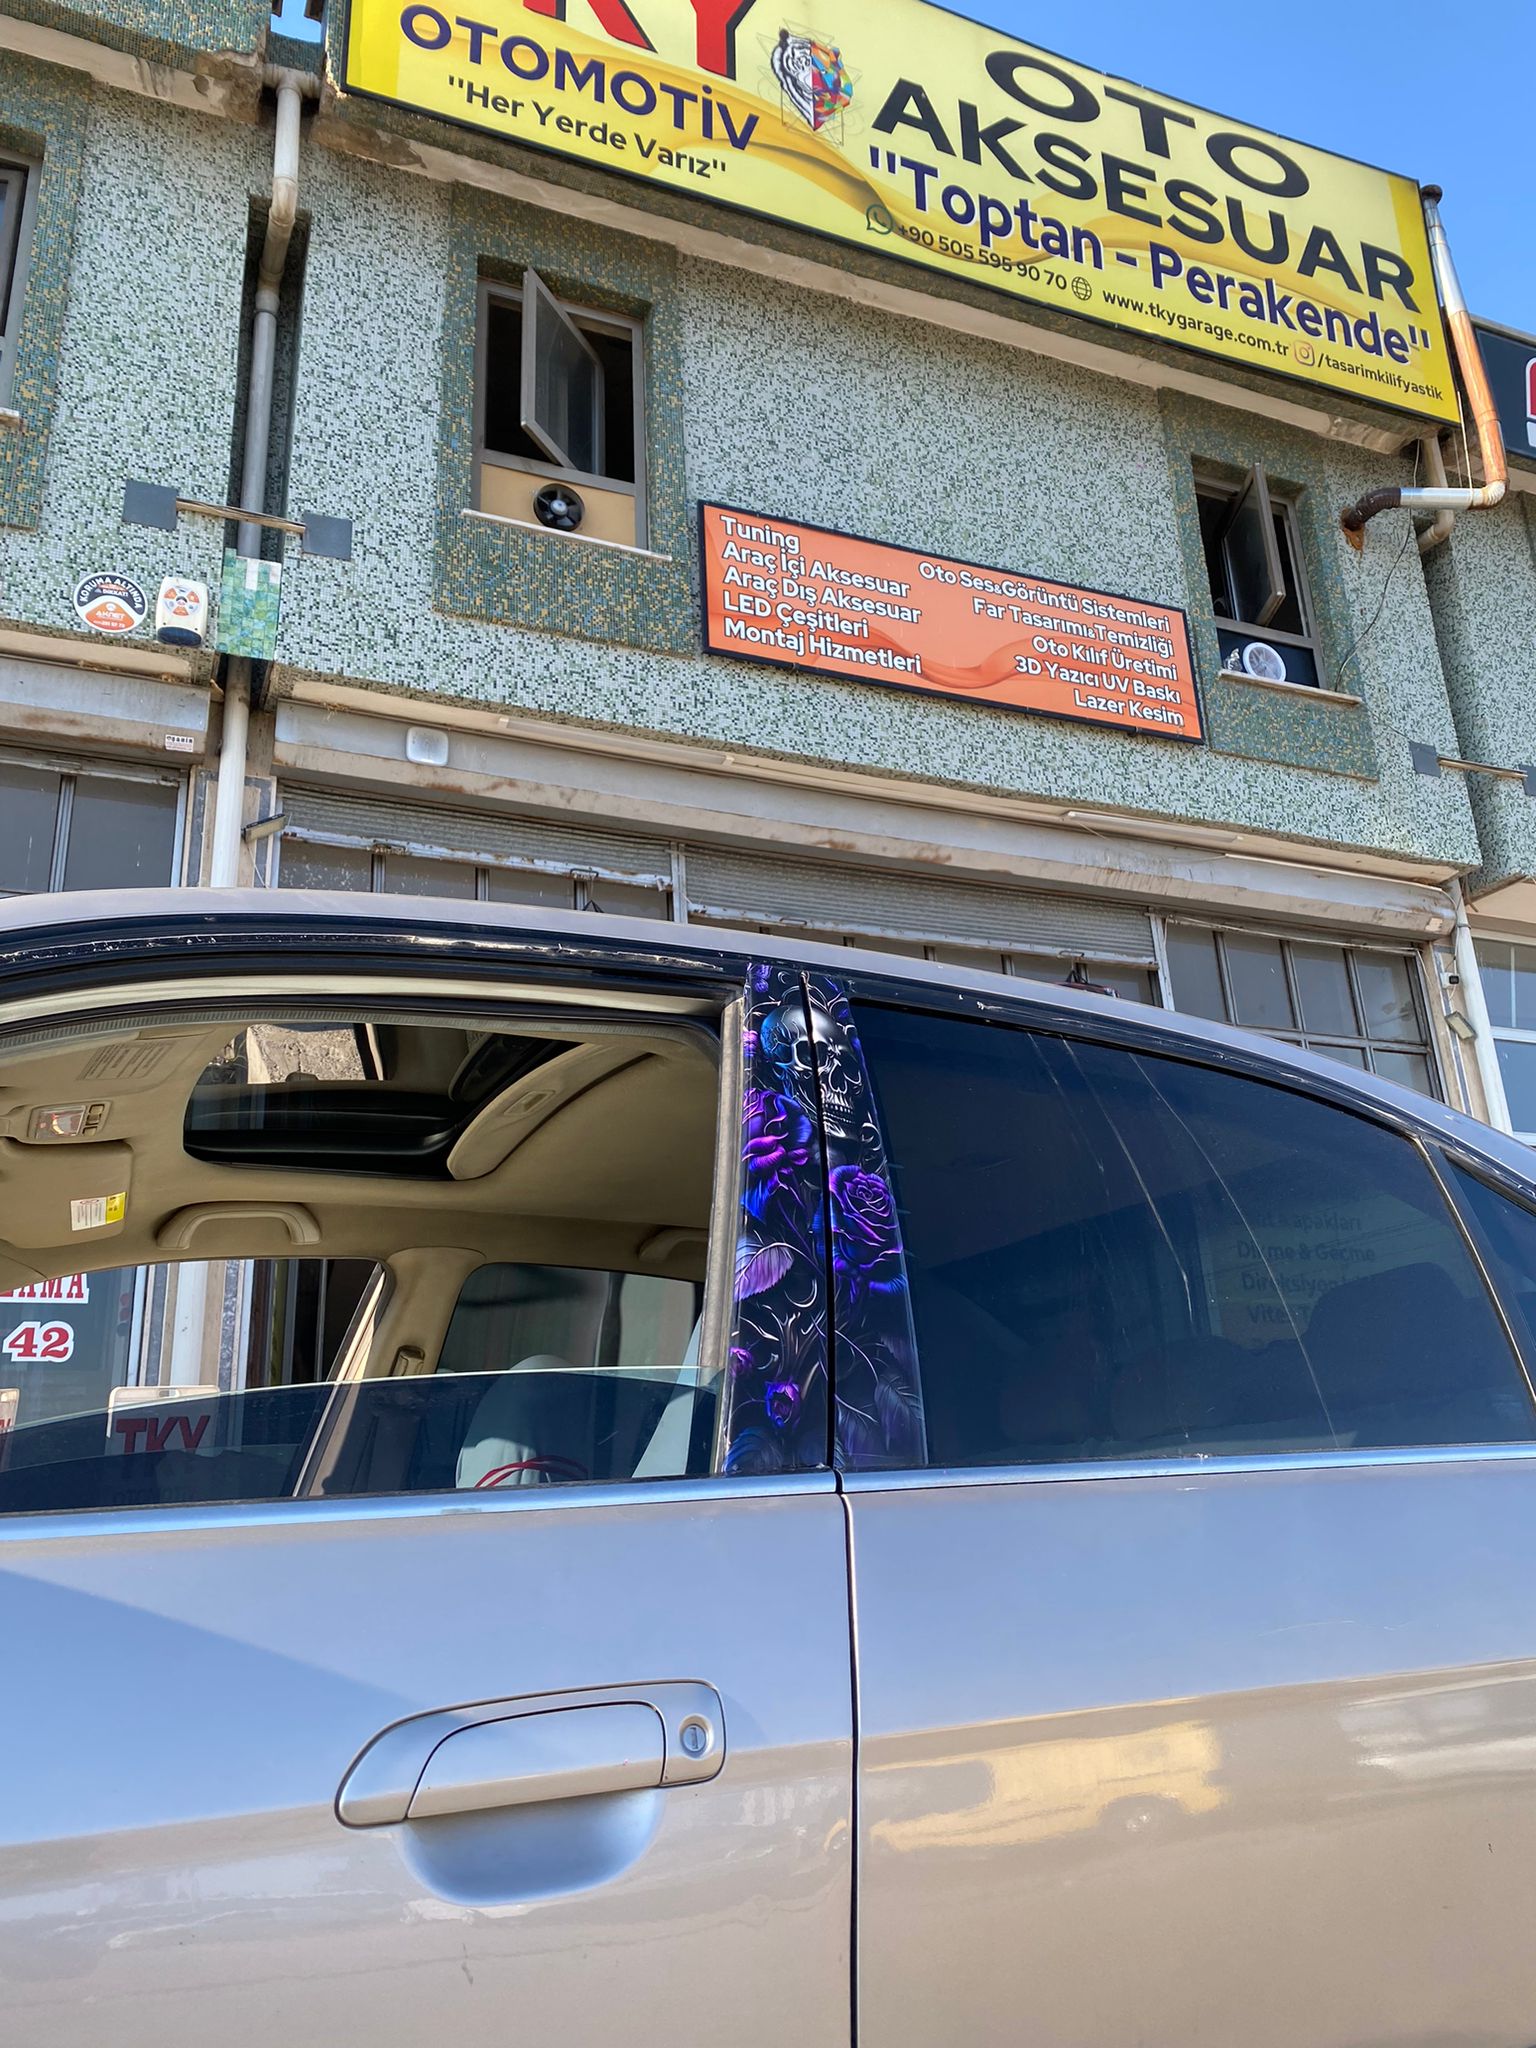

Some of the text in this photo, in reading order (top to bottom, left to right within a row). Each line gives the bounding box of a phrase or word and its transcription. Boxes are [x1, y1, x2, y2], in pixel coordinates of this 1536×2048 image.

[400, 4, 760, 151] OTOMOTİV
[449, 75, 726, 179] "Her Yerde Varız"
[985, 50, 1310, 198] OTO
[871, 78, 1422, 312] AKSESUAR
[869, 144, 1103, 271] "Toptan
[1151, 240, 1431, 365] Perakende"
[899, 225, 1067, 290] +90 505 595 90 70
[1102, 289, 1289, 357] www.tkygarage.com.tr
[1317, 353, 1443, 401] /tasarimkilifyastik
[720, 515, 800, 555] Tuning
[79, 577, 144, 609] KORUMA ALTINDA
[722, 541, 911, 598] Araç İçi Aksesuar
[723, 566, 922, 624] Araç Dış Aksesuar
[919, 562, 957, 585] Oto
[1081, 599, 1171, 632] Sistemleri
[723, 590, 869, 639] LED Çeşitleri
[973, 597, 1005, 620] Far
[724, 617, 922, 674] Montaj Hizmetleri
[1032, 635, 1178, 681] Oto Kılıf Üretimi
[1014, 655, 1181, 705] 3D Yazıcı UV Baskı
[1074, 689, 1184, 727] Lazer Kesim
[7, 1326, 70, 1359] 42
